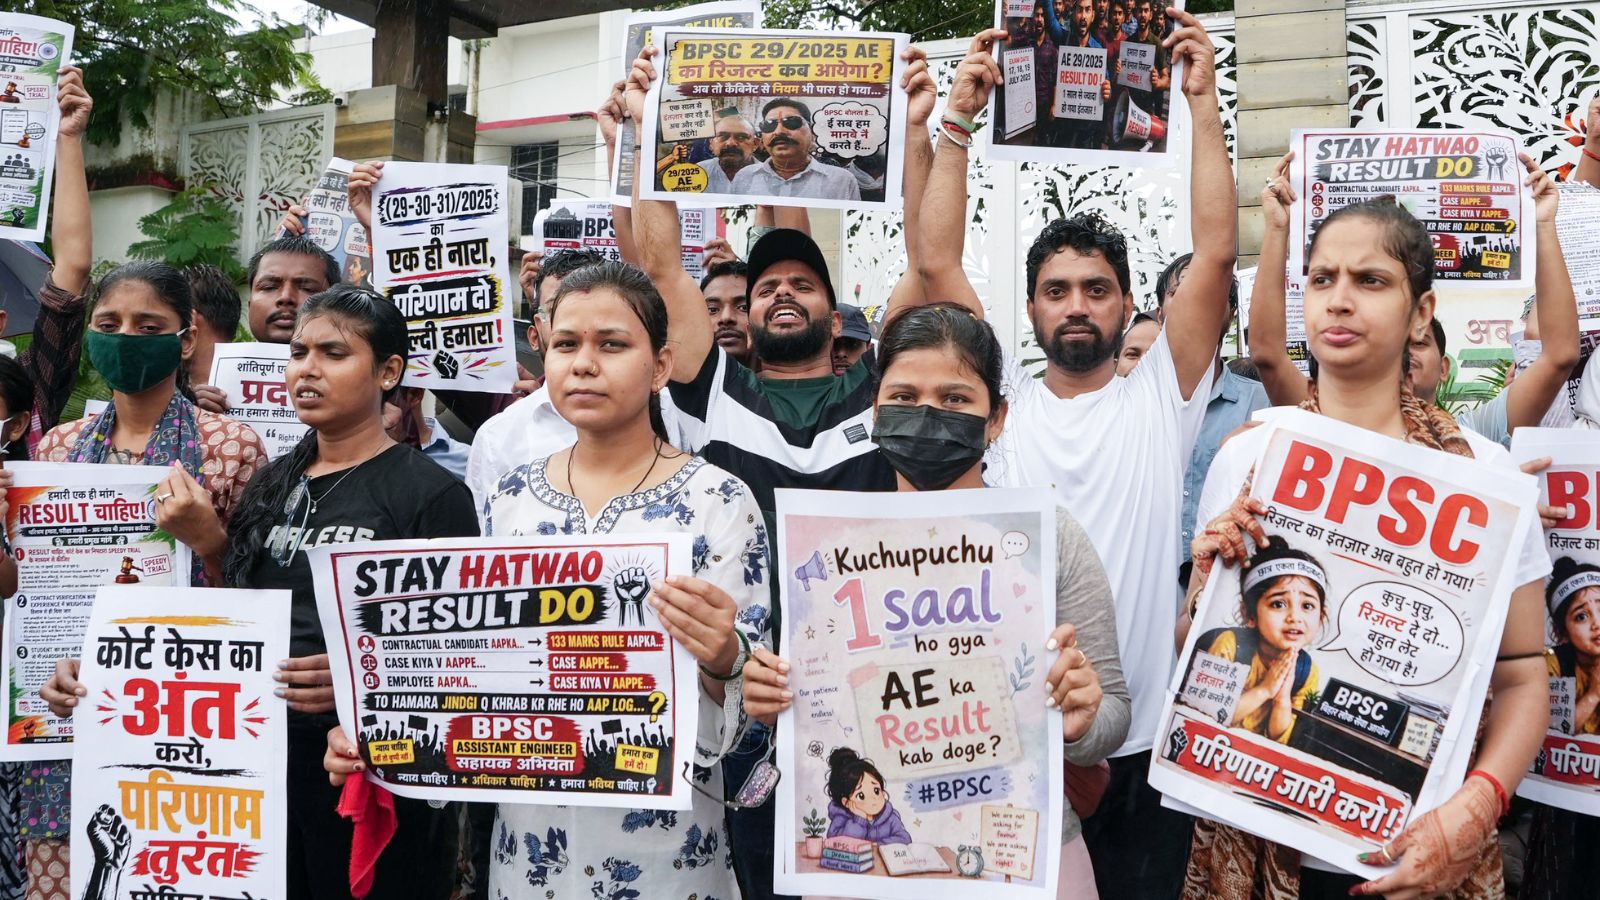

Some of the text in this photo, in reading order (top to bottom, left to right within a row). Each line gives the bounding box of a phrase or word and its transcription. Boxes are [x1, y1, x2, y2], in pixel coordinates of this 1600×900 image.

[683, 41, 878, 60] BPSC 29/2025 AE
[1061, 52, 1103, 68] AE 29/2025
[679, 65, 704, 79] का
[708, 60, 774, 78] रिजल्ट
[778, 64, 810, 78] कब
[1008, 74, 1031, 85] JULY 2025
[693, 85, 709, 94] अब
[712, 83, 723, 94] तो
[725, 83, 759, 94] कैबिनेट
[761, 84, 771, 94] से
[773, 84, 800, 94] नियम
[802, 84, 814, 94] भी
[817, 86, 836, 95] पास
[838, 84, 850, 96] हो
[1127, 120, 1149, 138] RESULT
[1316, 137, 1479, 160] STAY HATWAO
[668, 168, 700, 177] 29/2025
[1330, 157, 1473, 182] RESULT DO
[678, 177, 692, 186] AE
[386, 189, 492, 220] (29-30-31)/2025
[1442, 196, 1486, 205] CASE AAPPE...
[1442, 208, 1507, 218] CASE KIYA V AAPPE...
[430, 223, 444, 236] का
[386, 237, 496, 273] एक ही नारा,
[393, 278, 492, 317] परिणाम दो
[408, 320, 437, 351] ल्दी
[237, 360, 275, 376] शांतिपूर्ण
[246, 408, 269, 417] हमारा
[278, 434, 294, 443] Right
[48, 488, 115, 501] हमारी एक ही मांग
[1271, 440, 1489, 565] BPSC
[20, 498, 146, 524] RESULT चाहिए!
[144, 557, 167, 567] SPEEDY
[834, 534, 993, 576] Kuchupuchu
[1306, 520, 1325, 541] का
[1326, 528, 1369, 556] इंतज़ार
[1371, 546, 1394, 564] अब
[1396, 553, 1424, 577] बहुत
[1426, 562, 1441, 582] हो
[1442, 570, 1474, 592] गया!
[148, 565, 166, 573] TRIAL
[353, 550, 603, 597] STAY HATWAO
[380, 587, 595, 634] RESULT DO
[833, 568, 1001, 650] 1 saal
[97, 626, 155, 670] कोर्ट
[163, 628, 222, 671] केस
[229, 640, 264, 672] का
[382, 638, 525, 651] CONTRACTUAL CANDIDATE AAPKA...
[550, 634, 664, 648] 133 MARKS RULE AAPKA...
[915, 634, 986, 656] ho gya
[1368, 629, 1420, 659] बहुत लेट
[385, 657, 486, 669] CASE KIYA V AAPPE...
[552, 657, 619, 669] CASE AAPPE...
[1360, 646, 1418, 679] हो गया है!
[388, 676, 477, 688] EMPLOYEE AAPKA...
[554, 677, 652, 689] CASE KIYA V AAPPE...
[881, 668, 975, 711] AE ka
[122, 671, 241, 740] अंत
[375, 695, 388, 708] TO
[391, 695, 438, 709] HAMARA
[441, 696, 477, 710] JINDGI
[481, 697, 489, 711] Q
[492, 697, 528, 710] KHRAB
[531, 697, 545, 710] KR
[548, 697, 567, 711] RHE
[570, 697, 584, 711] HO
[587, 697, 610, 711] AAP
[612, 698, 645, 712] LOG...
[1333, 686, 1388, 721] BPSC
[472, 716, 553, 741] BPSC
[875, 700, 991, 749] Result
[155, 737, 212, 768] करो,
[456, 742, 573, 755] ASSISTANT ENGINEER
[621, 747, 653, 761] हमारा हक
[899, 735, 1001, 766] kab doge?
[456, 756, 575, 772] सहायक अभियंता
[918, 775, 992, 805] #BPSC
[1191, 732, 1400, 838] परिणाम जारी करो!
[118, 770, 264, 840] परिणाम
[146, 831, 240, 885] तुरंत
